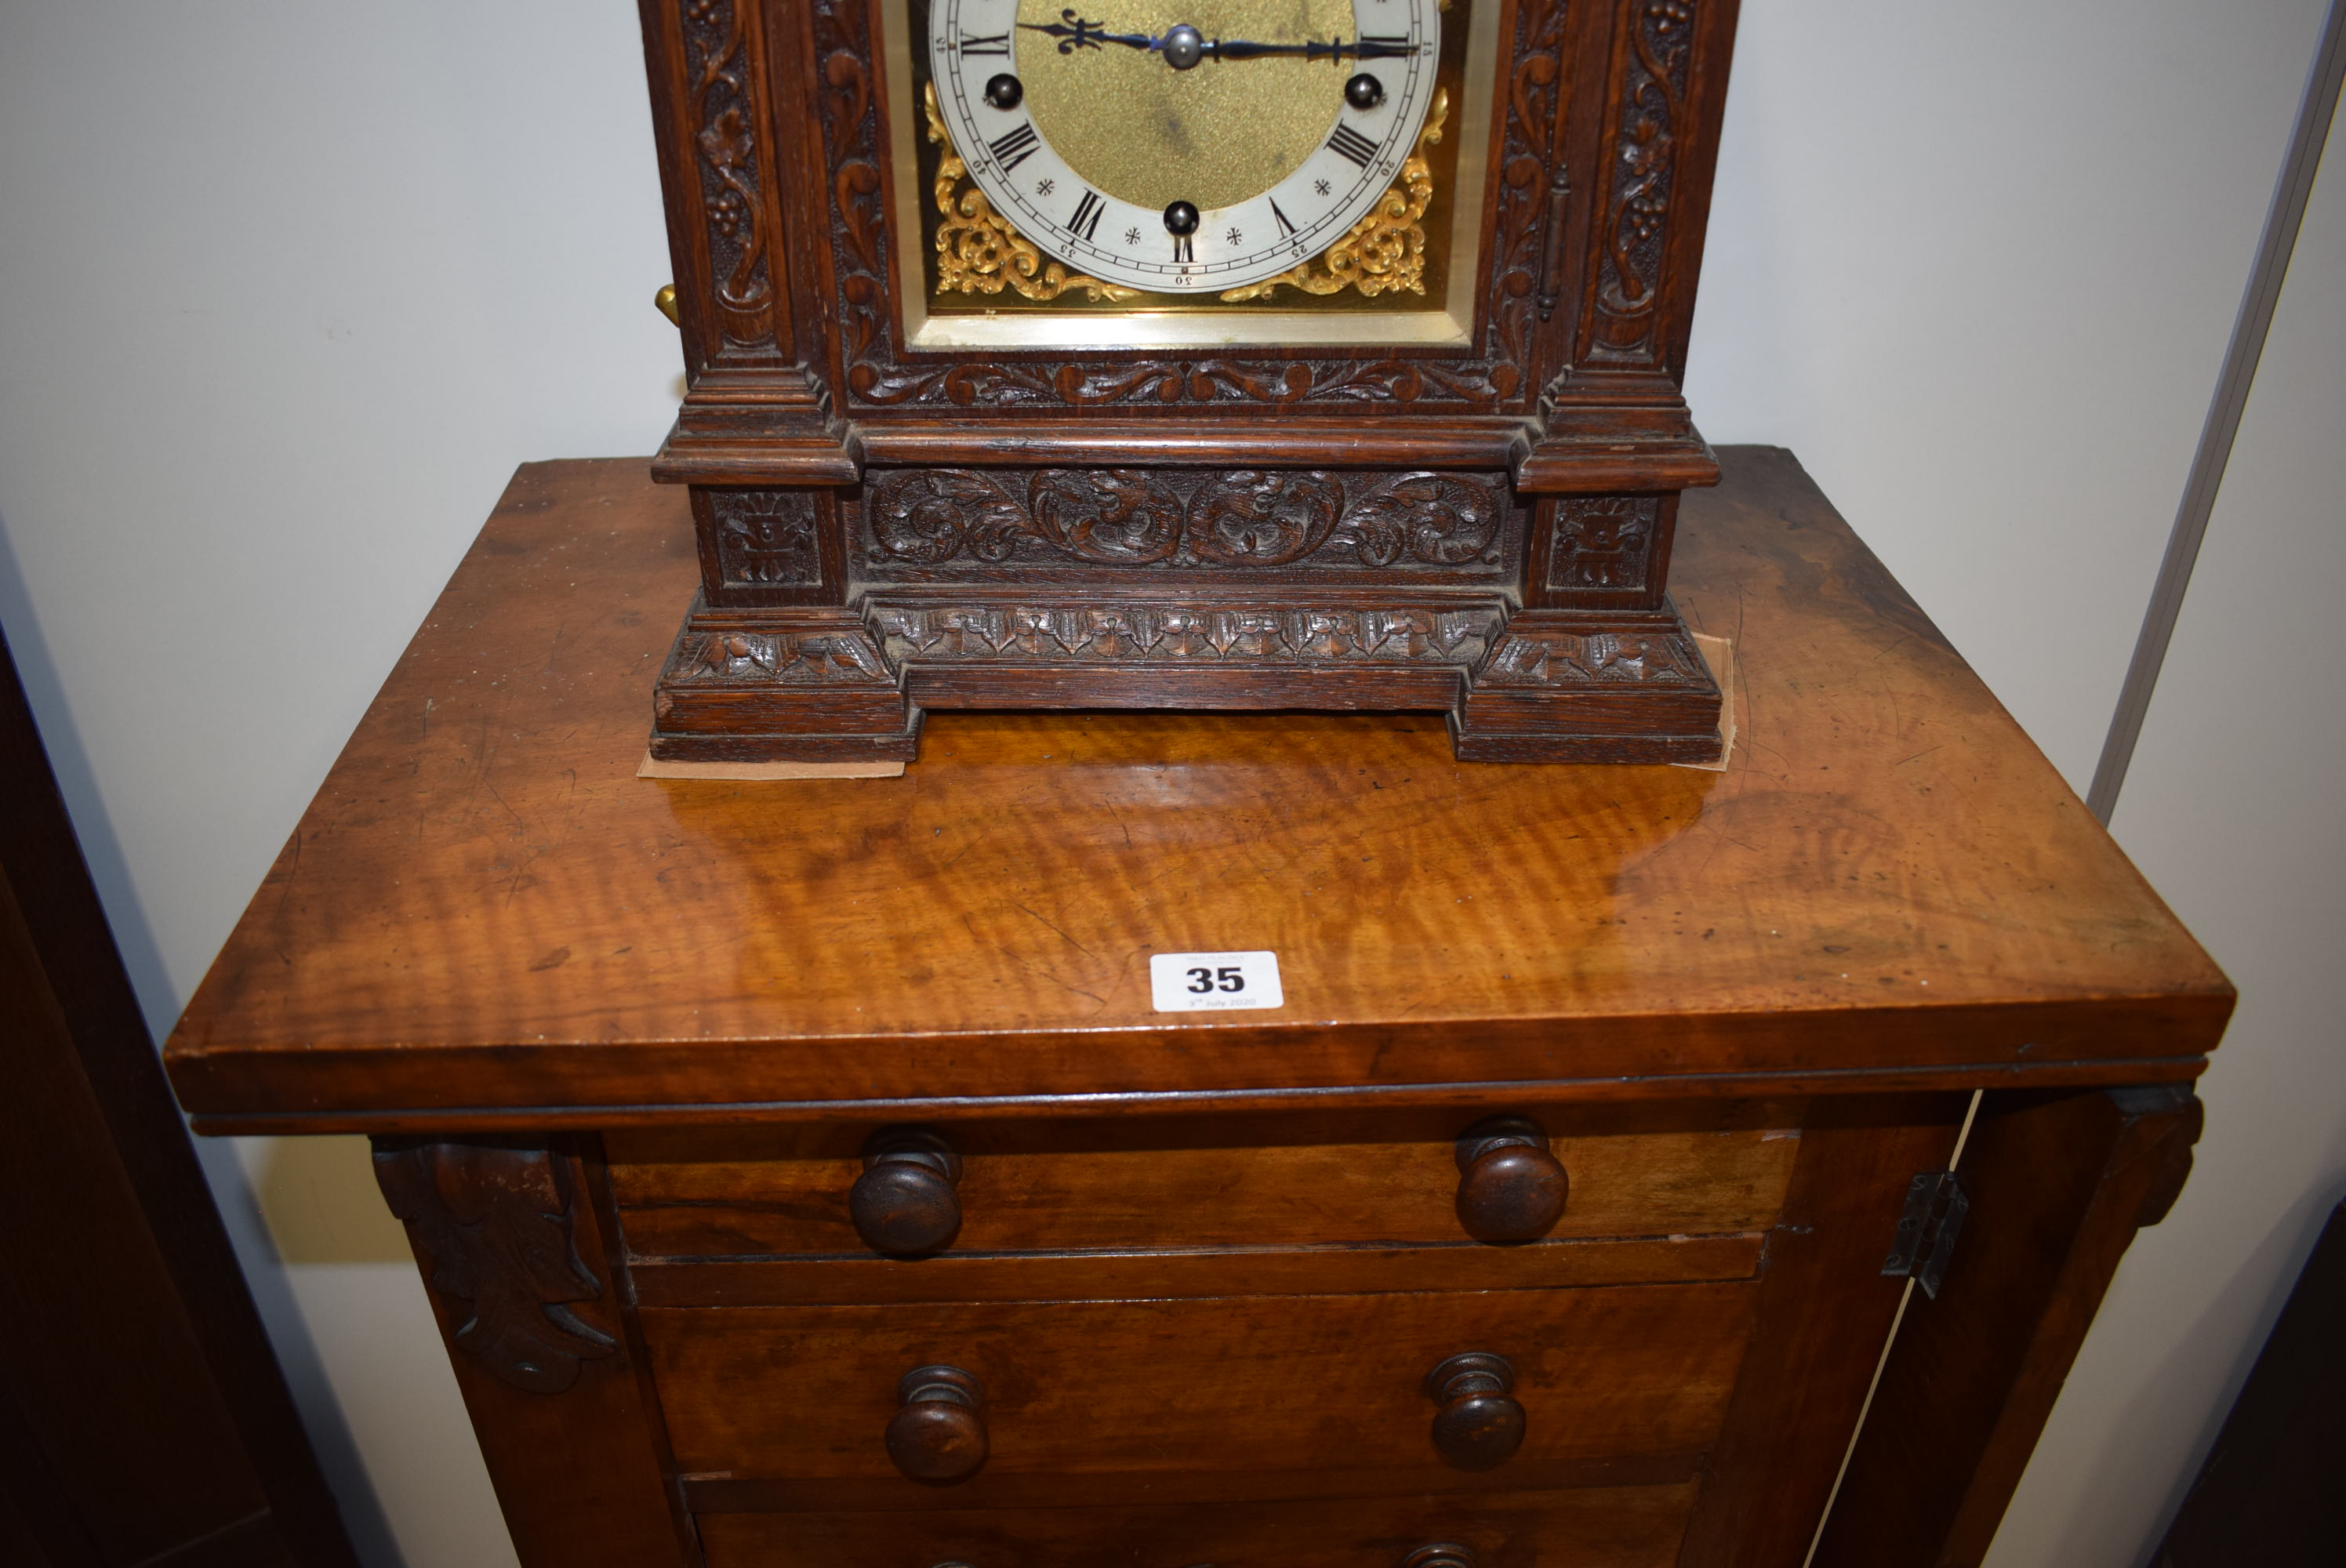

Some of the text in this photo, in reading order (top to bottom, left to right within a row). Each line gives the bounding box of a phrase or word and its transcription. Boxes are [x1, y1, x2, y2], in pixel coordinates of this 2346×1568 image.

[960, 28, 1011, 61] IX
[986, 118, 1041, 177] VIII
[1324, 118, 1382, 173] IIII
[972, 160, 986, 176] 40
[1380, 160, 1396, 176] 20
[1062, 187, 1107, 243] VII
[1269, 196, 1300, 241] V
[1175, 276, 1193, 285] 30
[1186, 967, 1245, 993] 35
